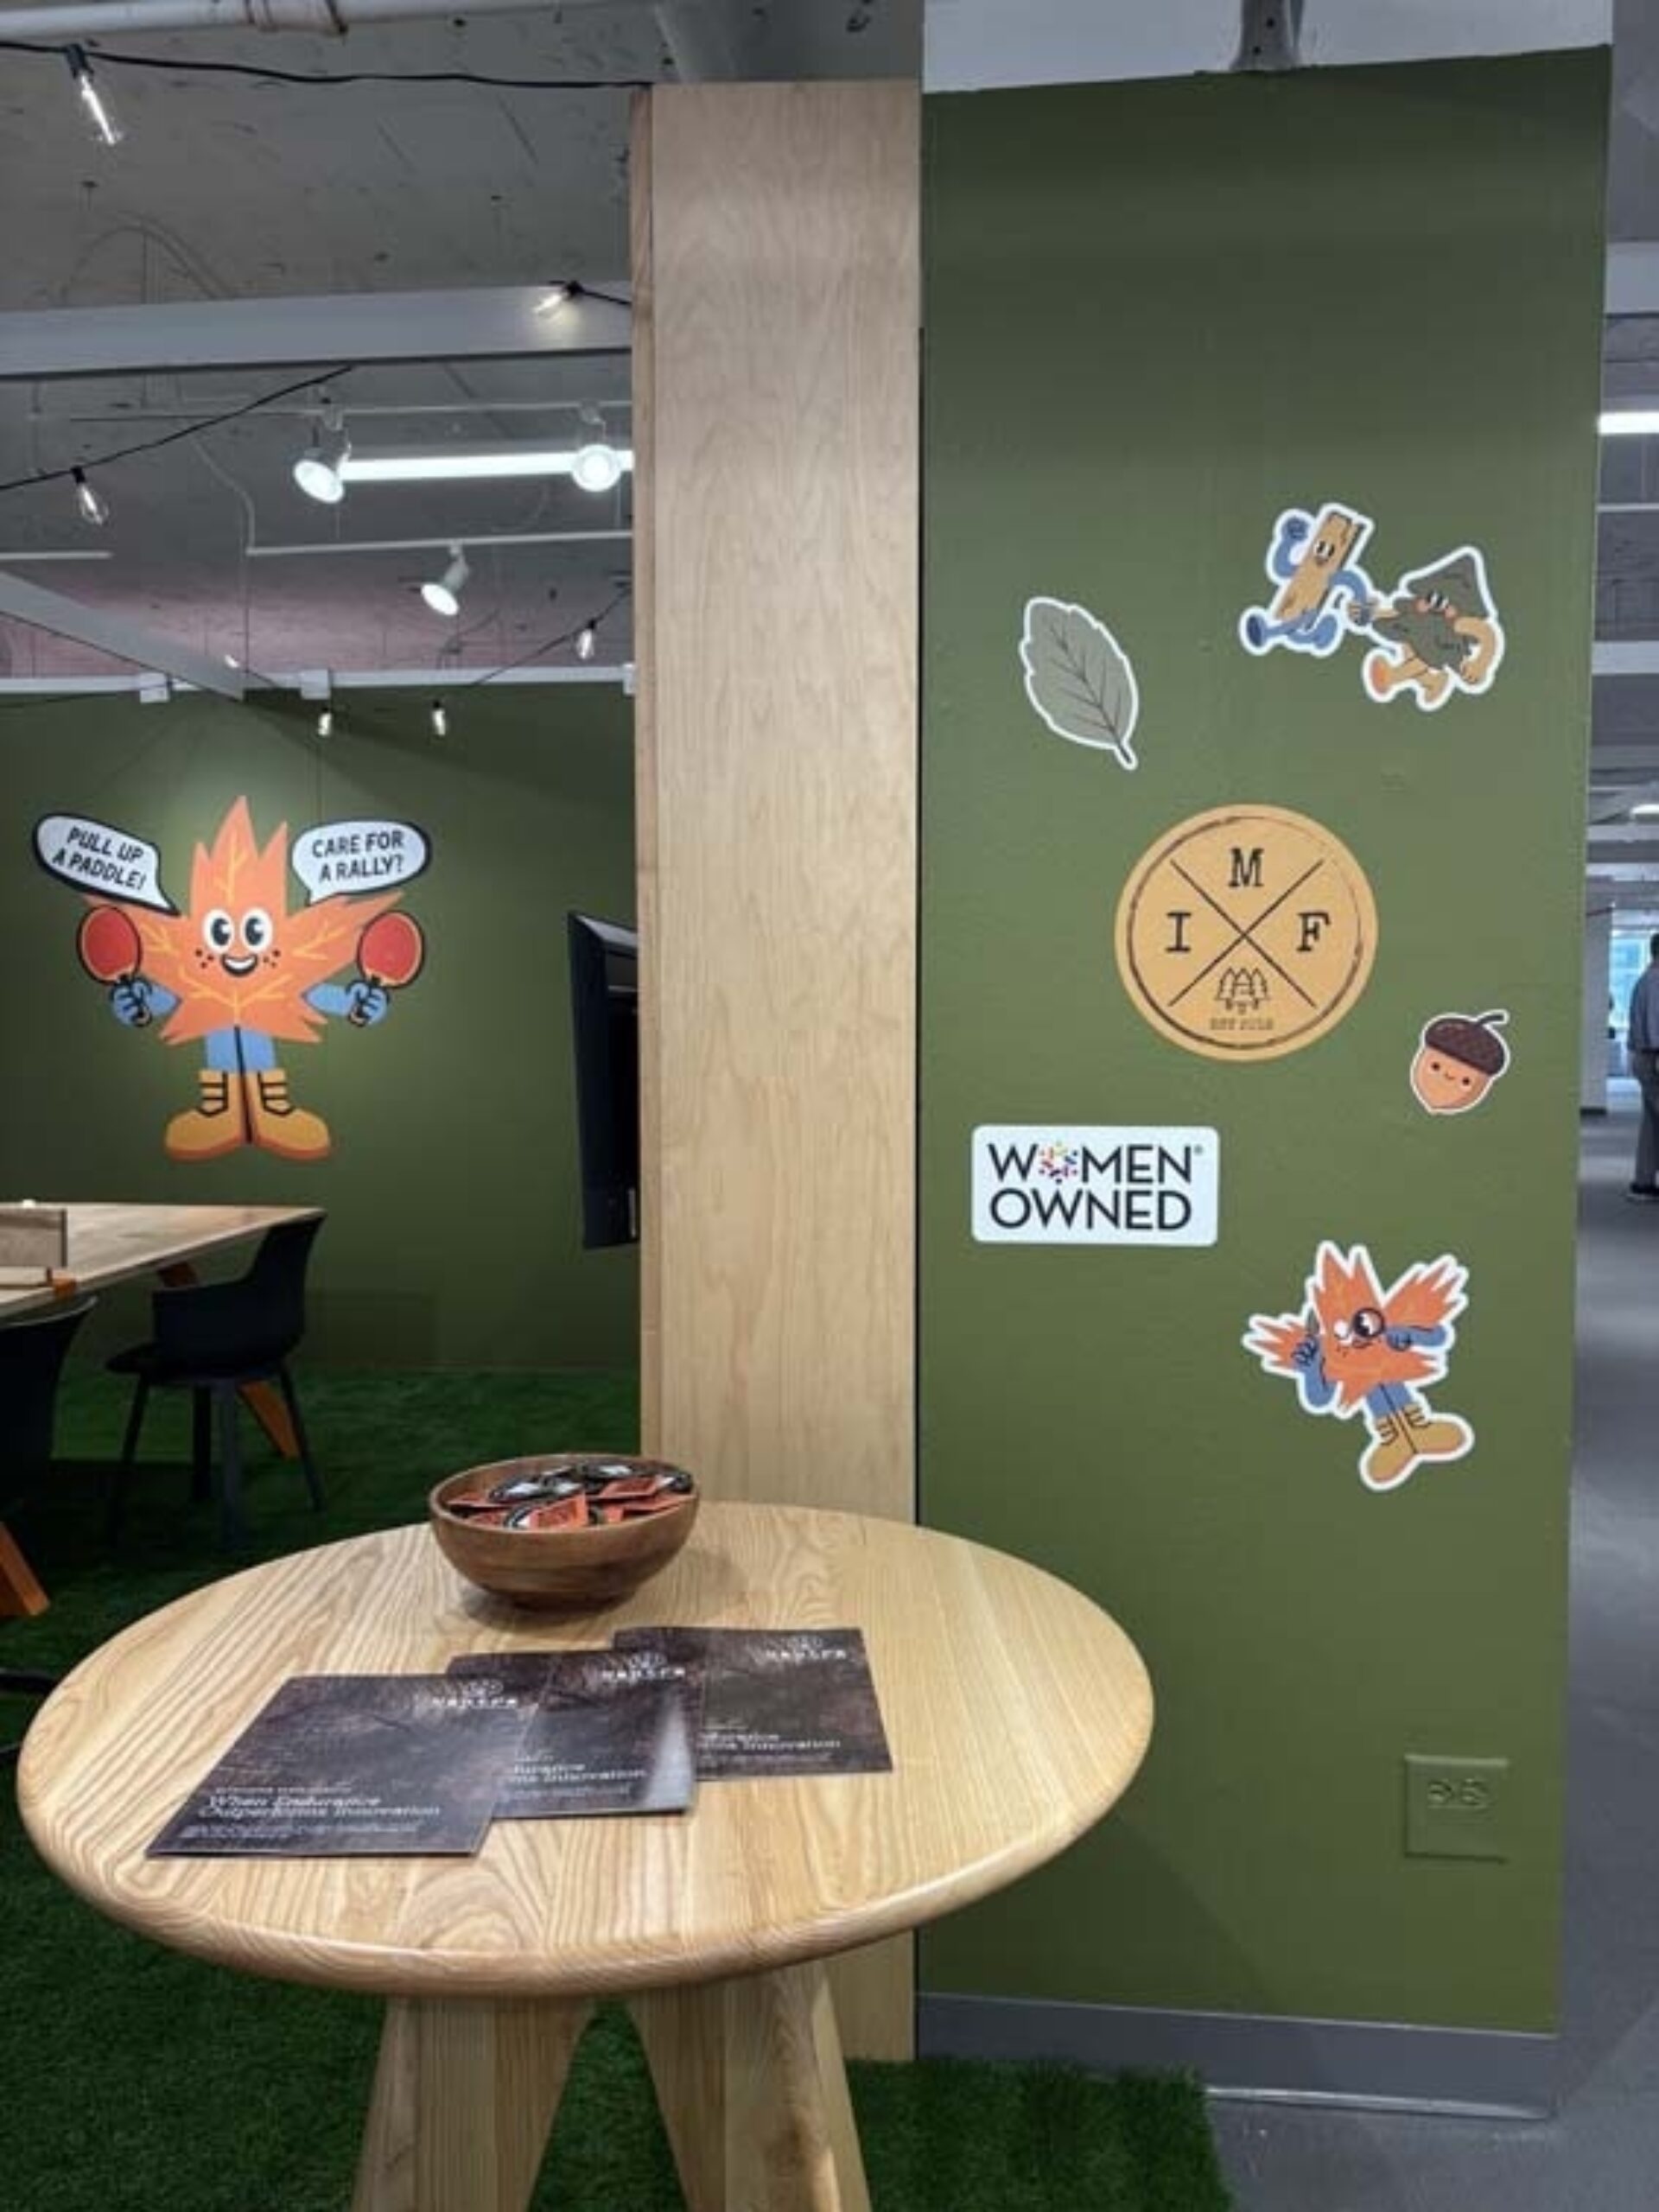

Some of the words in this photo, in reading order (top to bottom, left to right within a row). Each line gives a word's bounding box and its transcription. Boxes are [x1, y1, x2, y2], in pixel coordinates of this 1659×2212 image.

[67, 826, 111, 855] PULL
[117, 842, 143, 863] UP
[312, 834, 361, 859] CARE
[365, 830, 404, 852] FOR
[53, 848, 67, 866] A
[70, 852, 147, 891] PADDLE!
[320, 862, 332, 882] A
[336, 854, 404, 881] RALLY?
[1228, 848, 1265, 888] M
[1165, 912, 1192, 953] I
[1296, 912, 1332, 953] F
[989, 1187, 1192, 1230] OWNED
